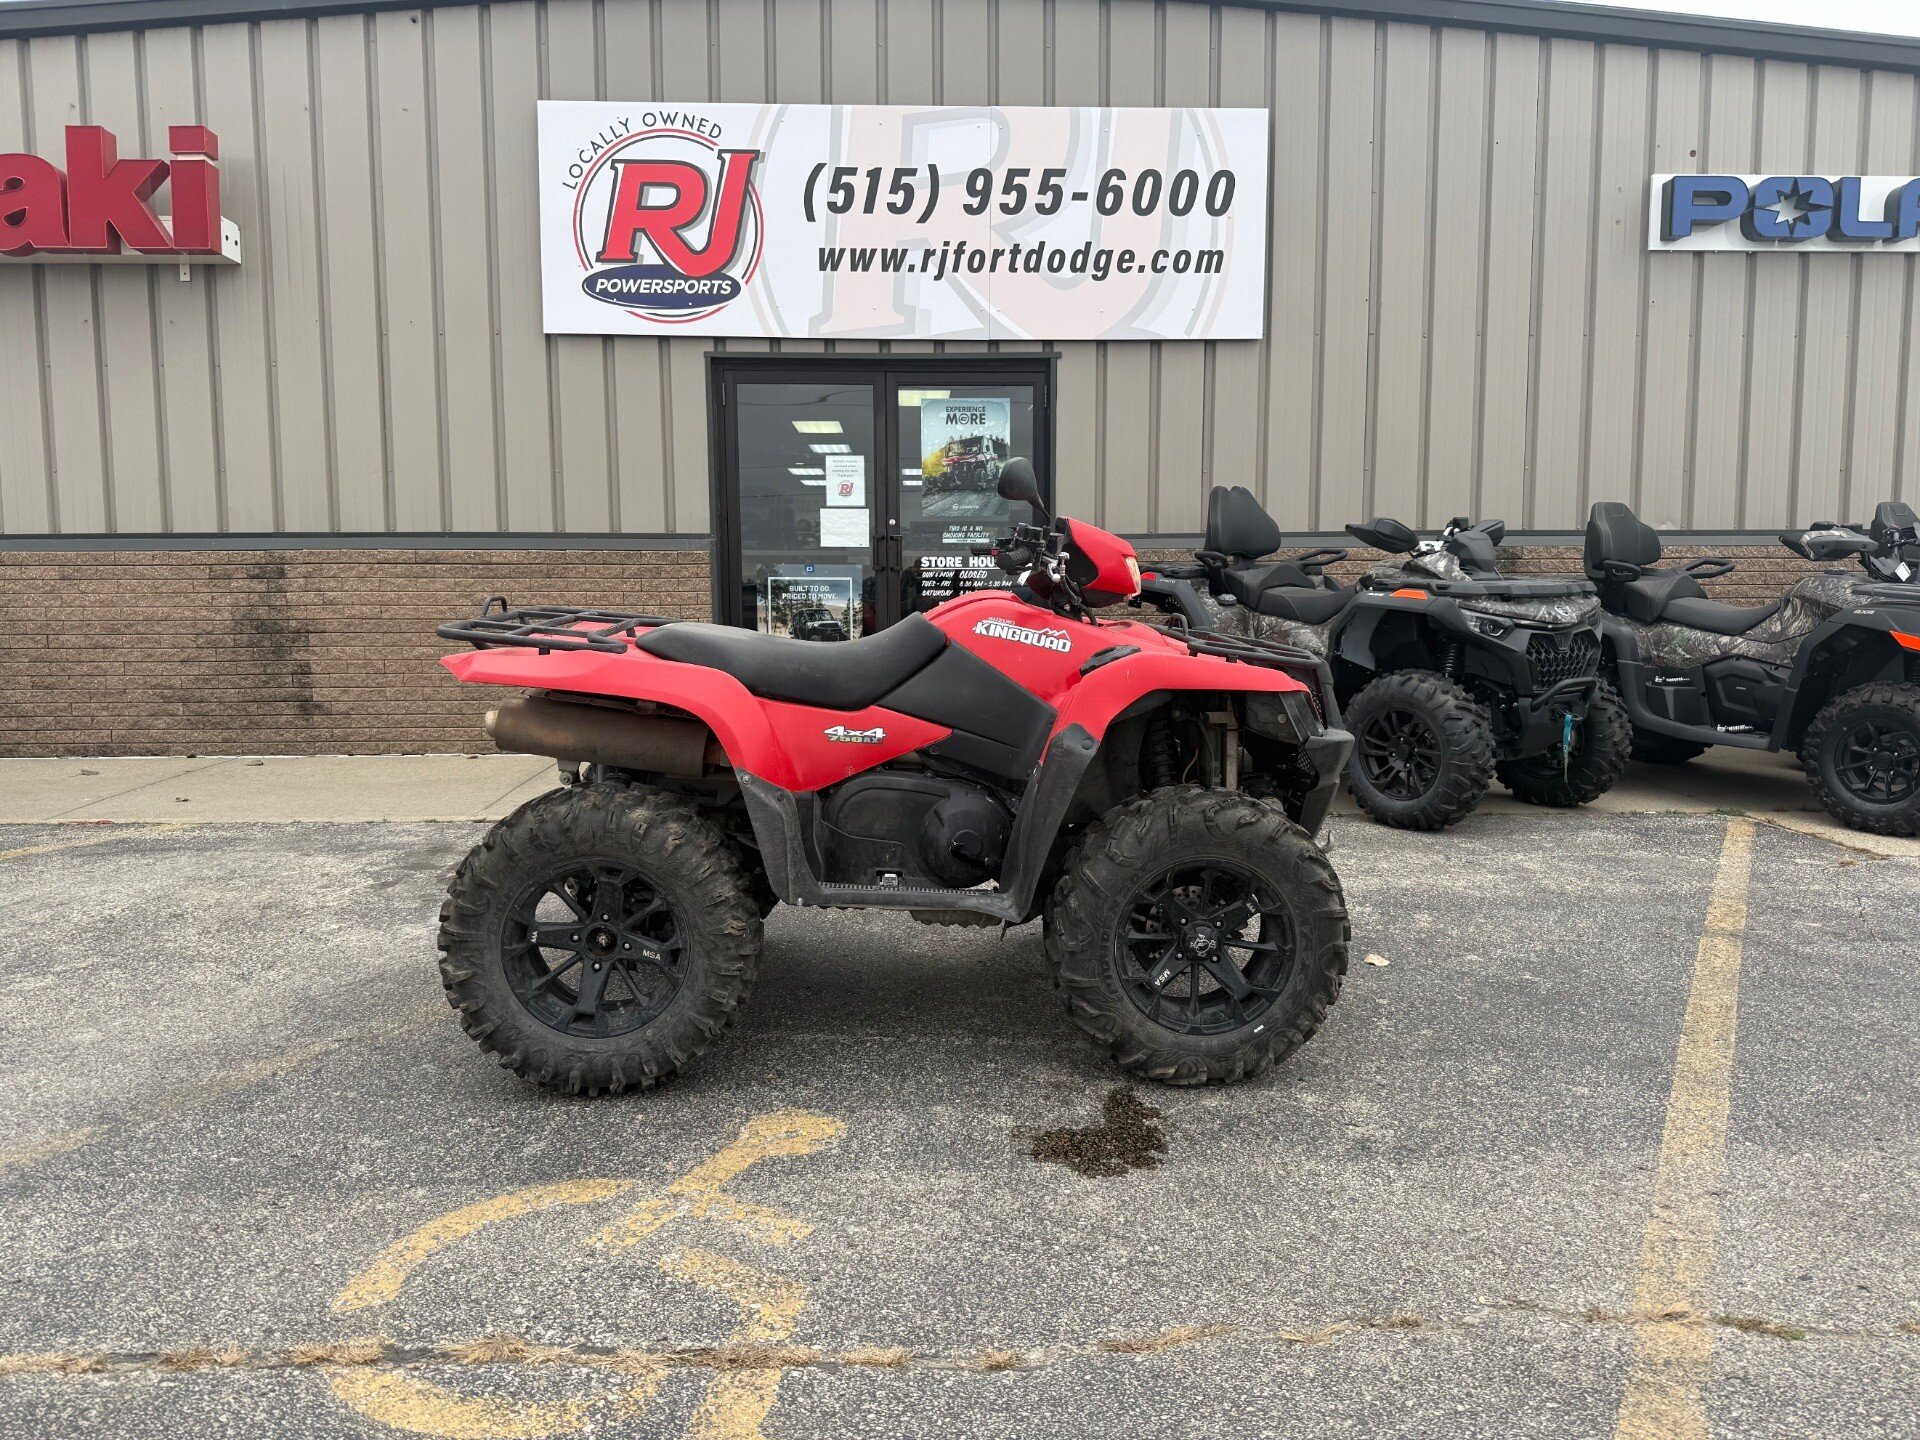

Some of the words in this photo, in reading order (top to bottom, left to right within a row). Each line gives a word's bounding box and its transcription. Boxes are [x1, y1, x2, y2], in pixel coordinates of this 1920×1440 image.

[562, 117, 631, 190] LOCALLY
[642, 110, 722, 139] OWNED
[803, 163, 940, 224] (515)
[962, 167, 1236, 217] 955-6000
[595, 149, 762, 277] RJ
[817, 240, 1224, 282] www.rjfortdodge.com
[595, 278, 732, 295] POWERSPORTS
[920, 556, 963, 568] STORE
[968, 556, 995, 568] HOU
[959, 570, 988, 579] CLOSED
[974, 621, 1072, 653] KINGQUAD
[823, 725, 884, 738] 4x4
[642, 949, 661, 961] MSA
[1154, 968, 1171, 986] MSA
